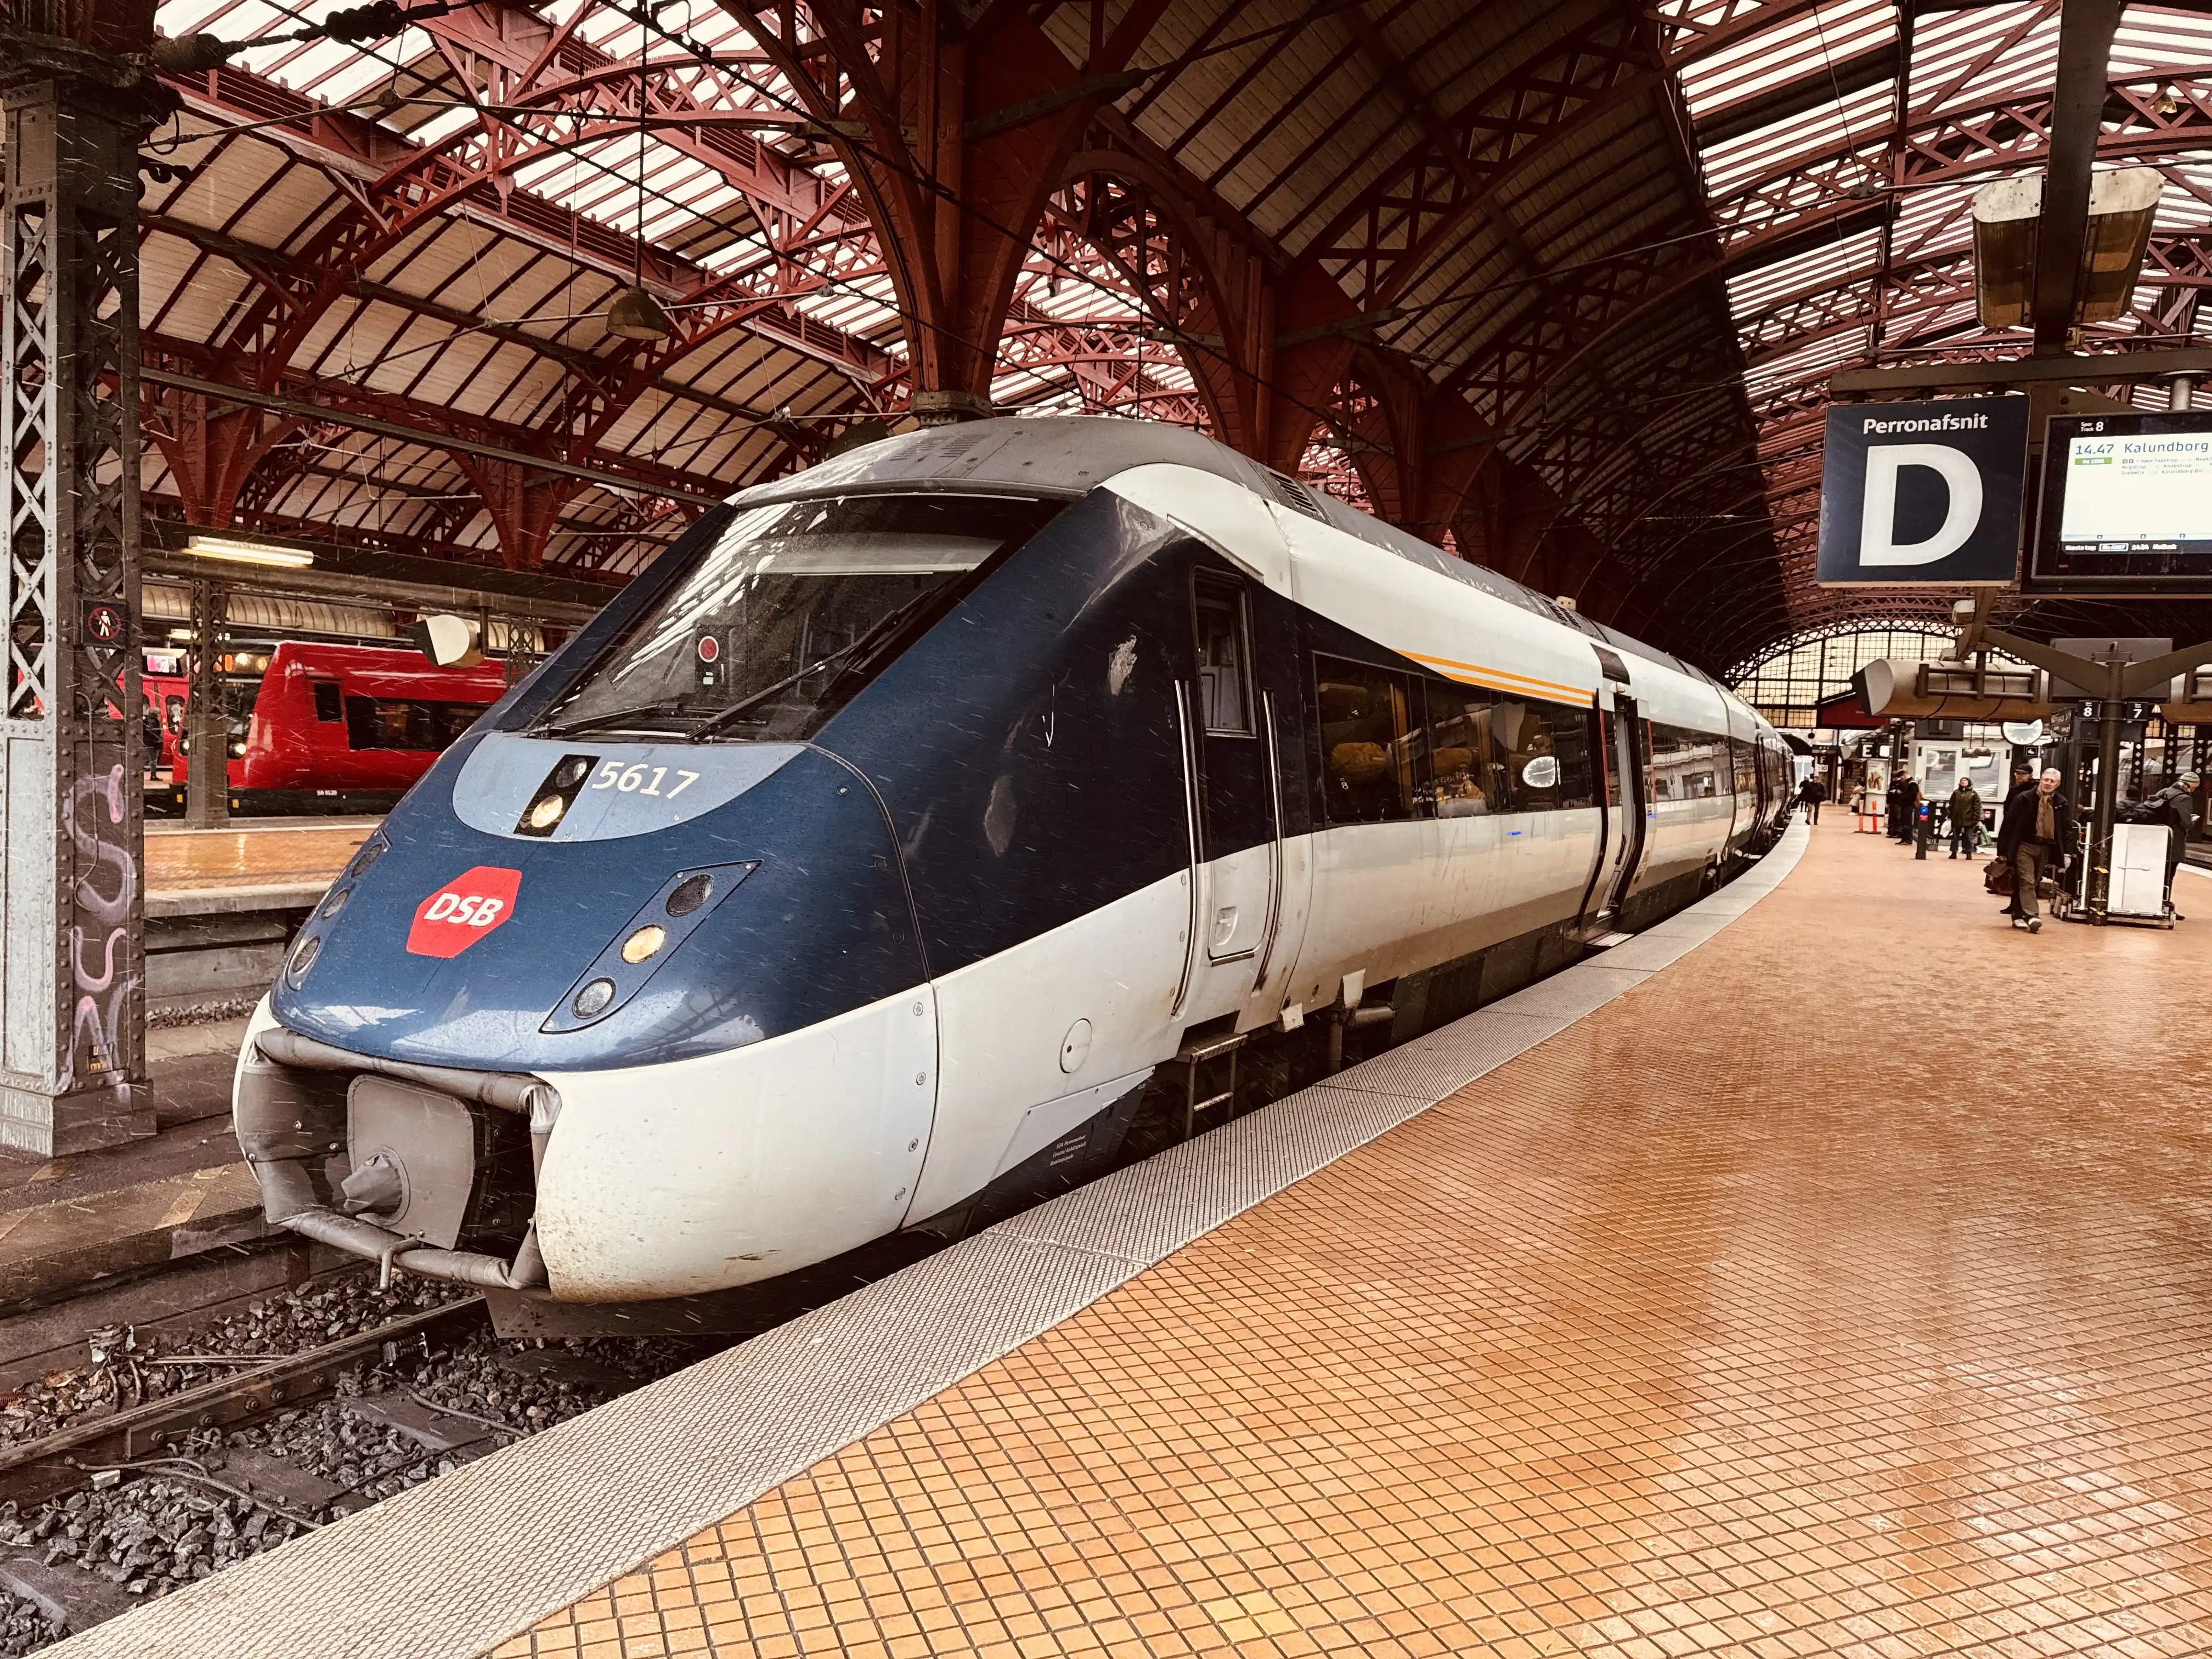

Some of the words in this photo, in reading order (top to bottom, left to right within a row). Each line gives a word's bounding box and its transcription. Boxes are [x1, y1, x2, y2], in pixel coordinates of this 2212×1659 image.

[1863, 413, 1989, 435] Perronafsnit
[2095, 421, 2104, 432] 8
[2075, 444, 2114, 455] 14.47
[2124, 441, 2209, 453] Kalundborg
[1859, 443, 1983, 566] D
[2083, 707, 2093, 717] 8
[2132, 708, 2142, 719] 7
[1862, 744, 1873, 758] E
[1820, 755, 1826, 764] F
[591, 761, 700, 800] 5617
[423, 893, 505, 927] DSB
